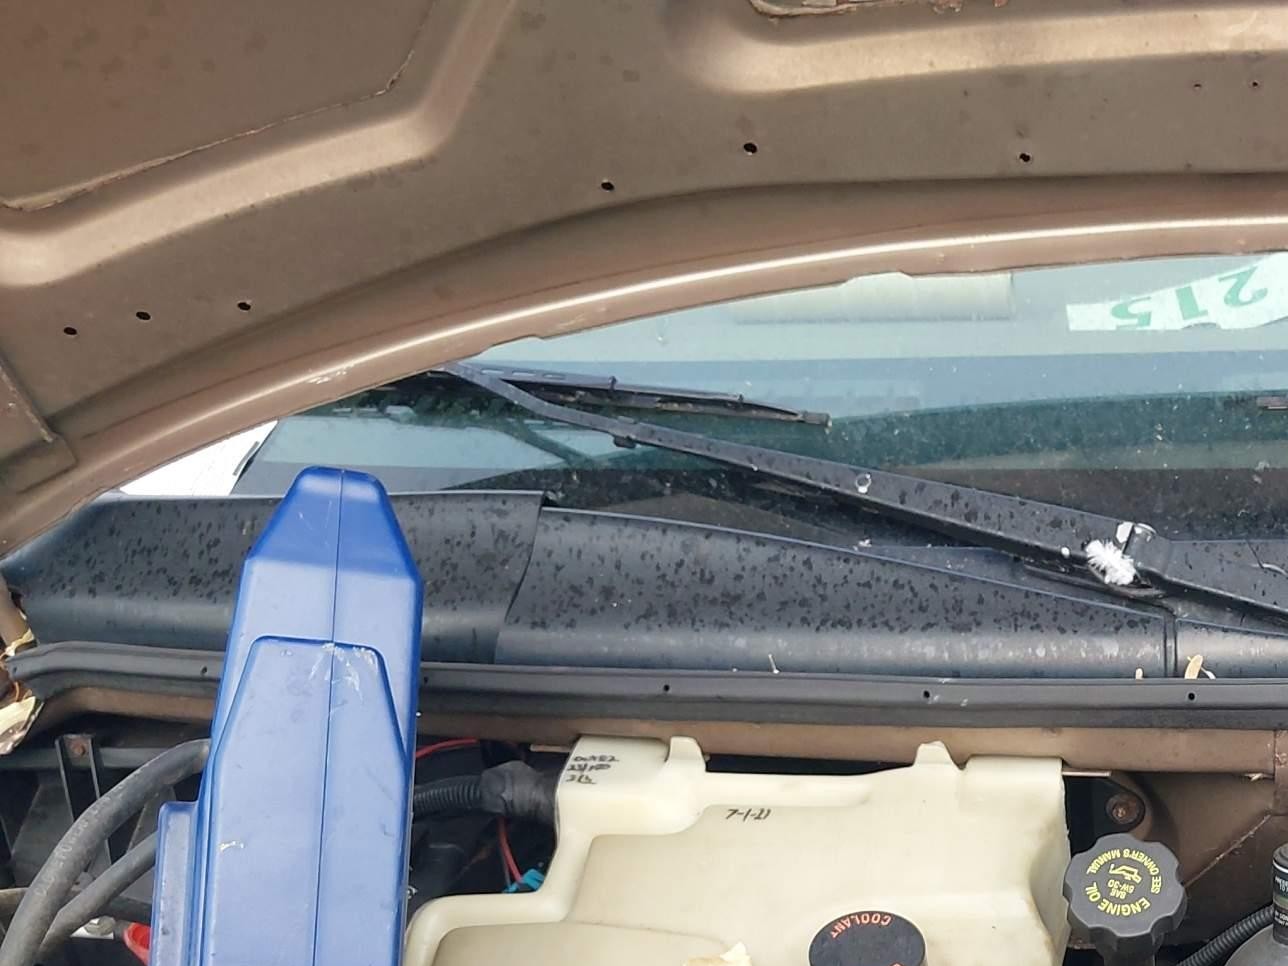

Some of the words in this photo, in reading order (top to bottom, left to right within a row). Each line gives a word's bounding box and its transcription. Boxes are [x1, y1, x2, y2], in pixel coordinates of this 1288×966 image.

[1111, 266, 1268, 329] 215
[1086, 848, 1121, 875] MANUAL
[1123, 849, 1160, 875] OWNER'S
[1085, 881, 1101, 902] OIL
[1150, 875, 1162, 895] SEE
[1097, 897, 1150, 916] ENGINE
[829, 912, 892, 939] COOLANT
